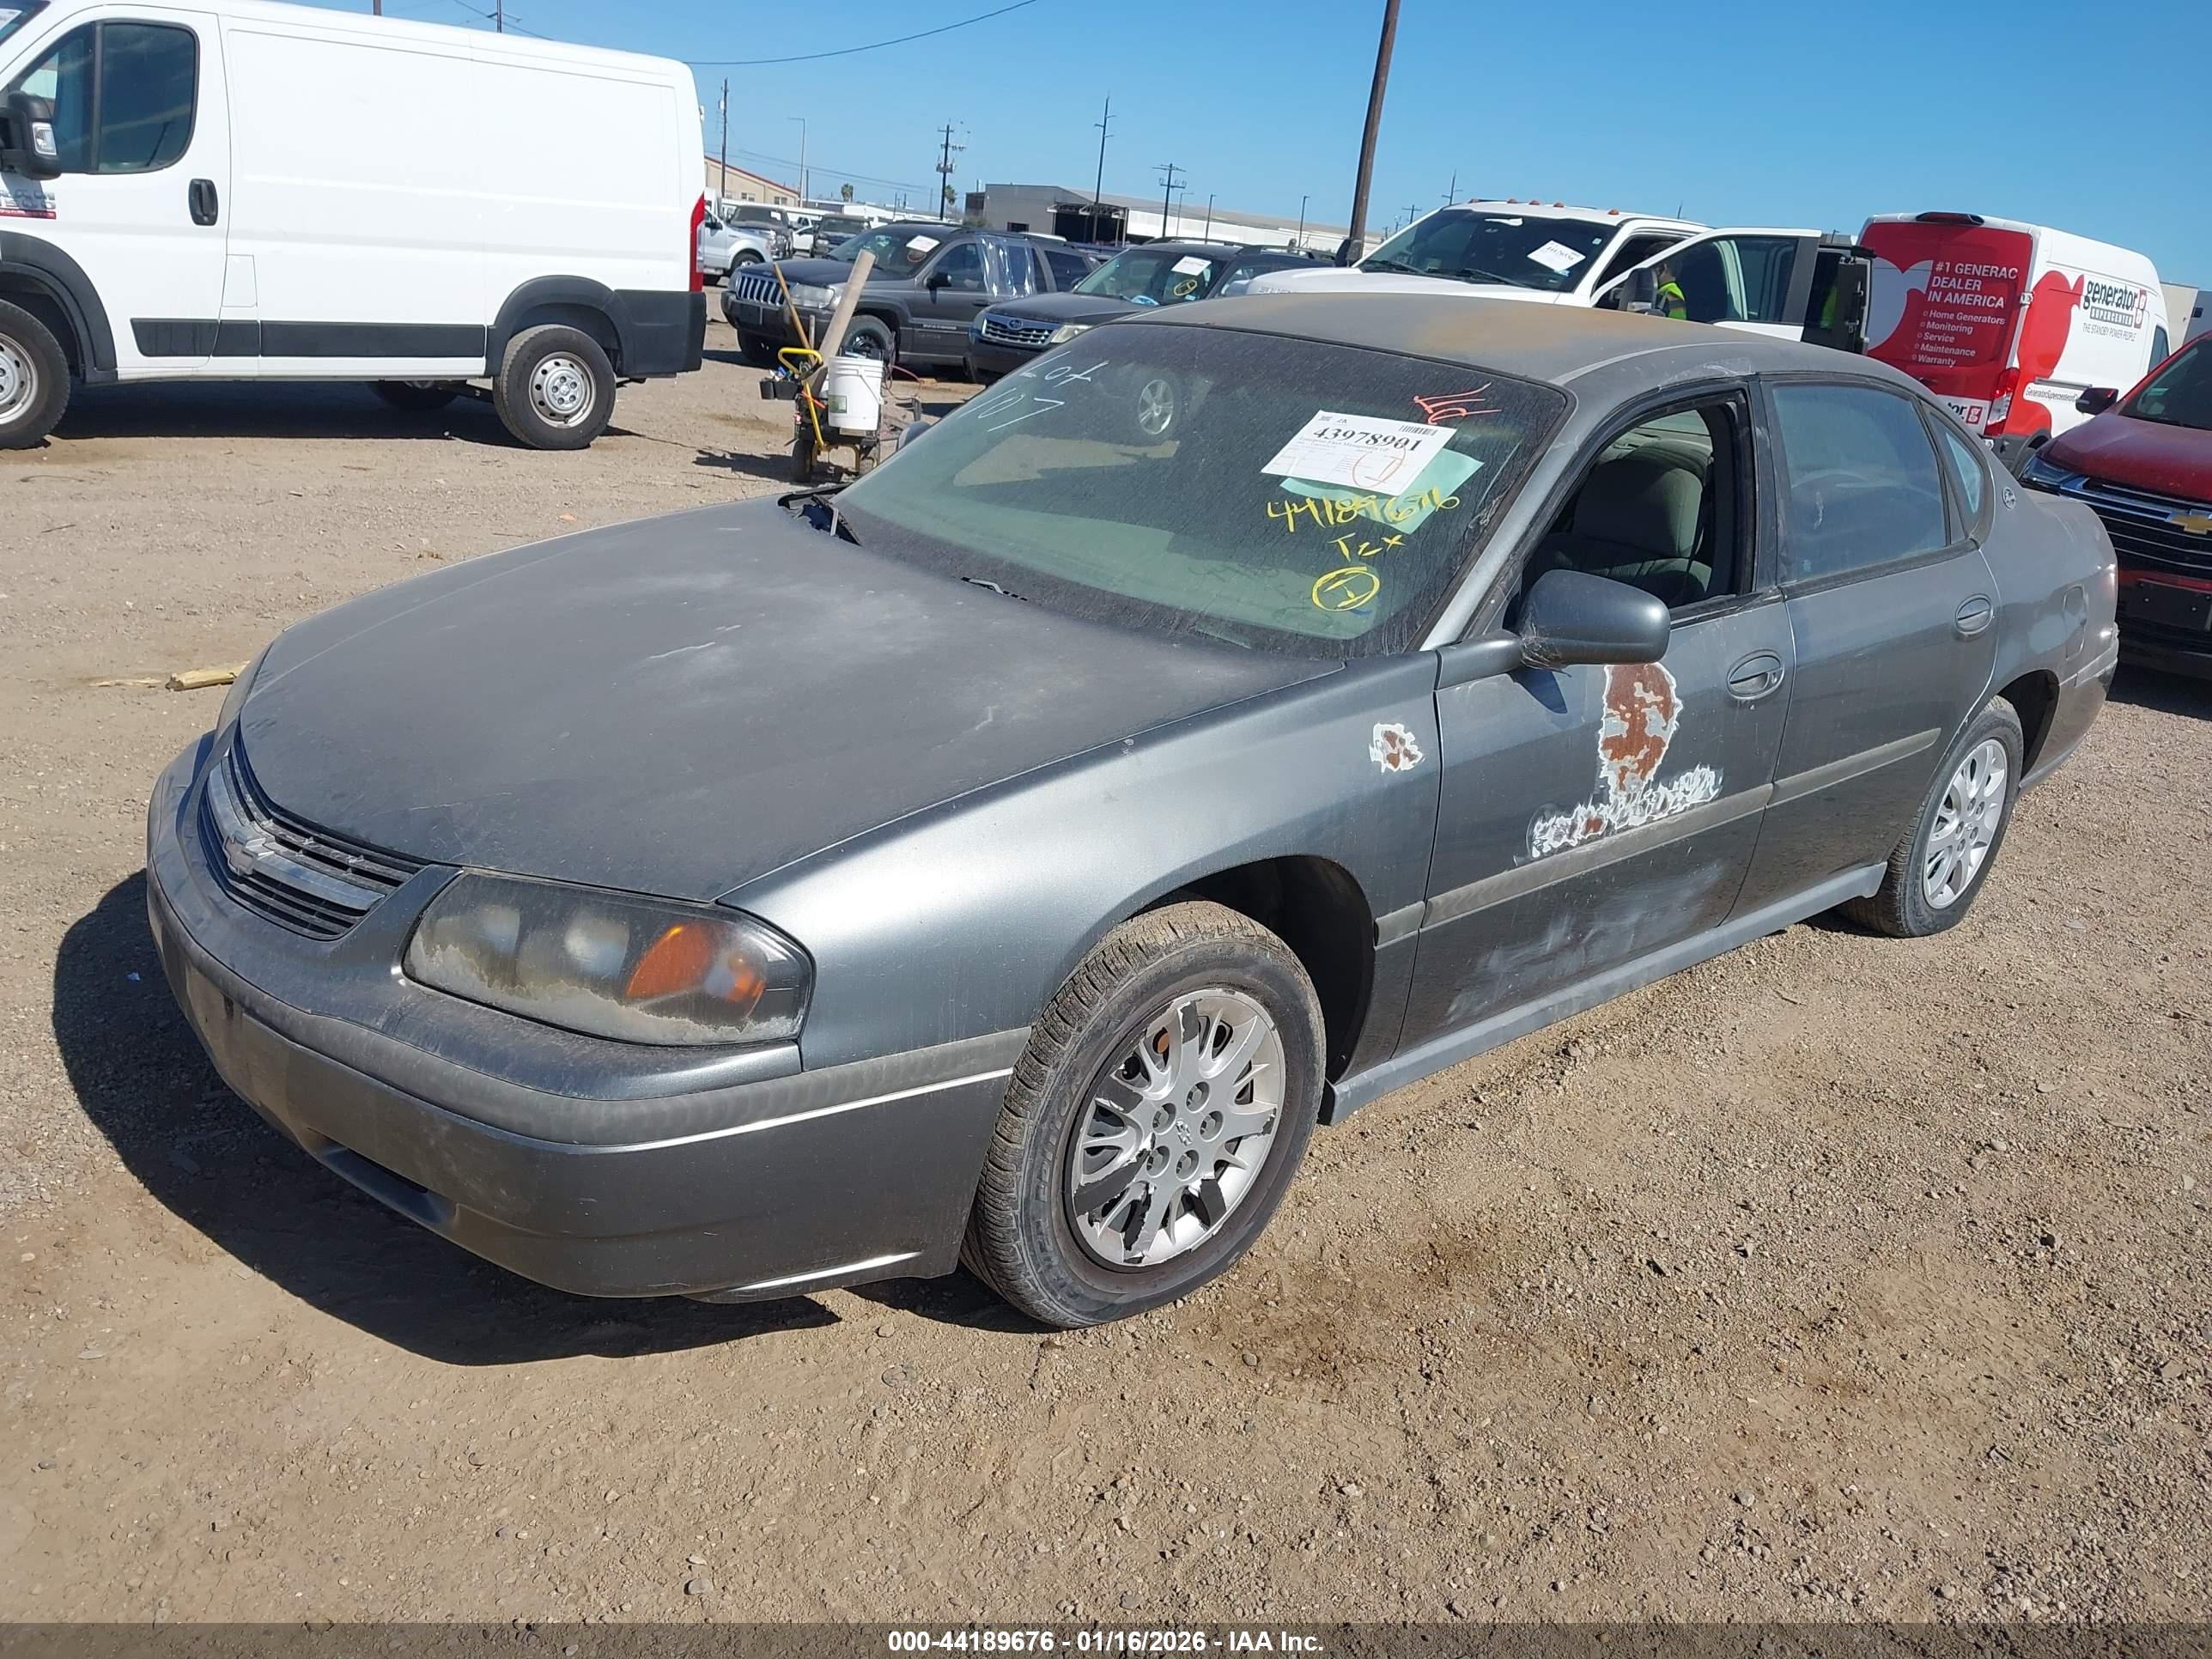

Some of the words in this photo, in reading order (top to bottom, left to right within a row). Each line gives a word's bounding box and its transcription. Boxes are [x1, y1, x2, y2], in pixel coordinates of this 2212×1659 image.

[1936, 261, 1951, 272] #1
[1954, 263, 2019, 279] GENERAC
[1931, 276, 1982, 291] DEALER
[1927, 290, 1942, 303] IN
[1944, 294, 2005, 308] AMERICA
[2083, 280, 2138, 311] generator
[1929, 309, 1954, 320] Home
[1956, 312, 2006, 325] Generators
[2090, 307, 2133, 326] SUPERCENTER
[1926, 320, 1973, 335] Monitoring
[1923, 331, 1955, 343] Service
[1920, 343, 1976, 356] Maintenance
[1917, 353, 1956, 368] Warranty
[1313, 427, 1423, 451] 43978901
